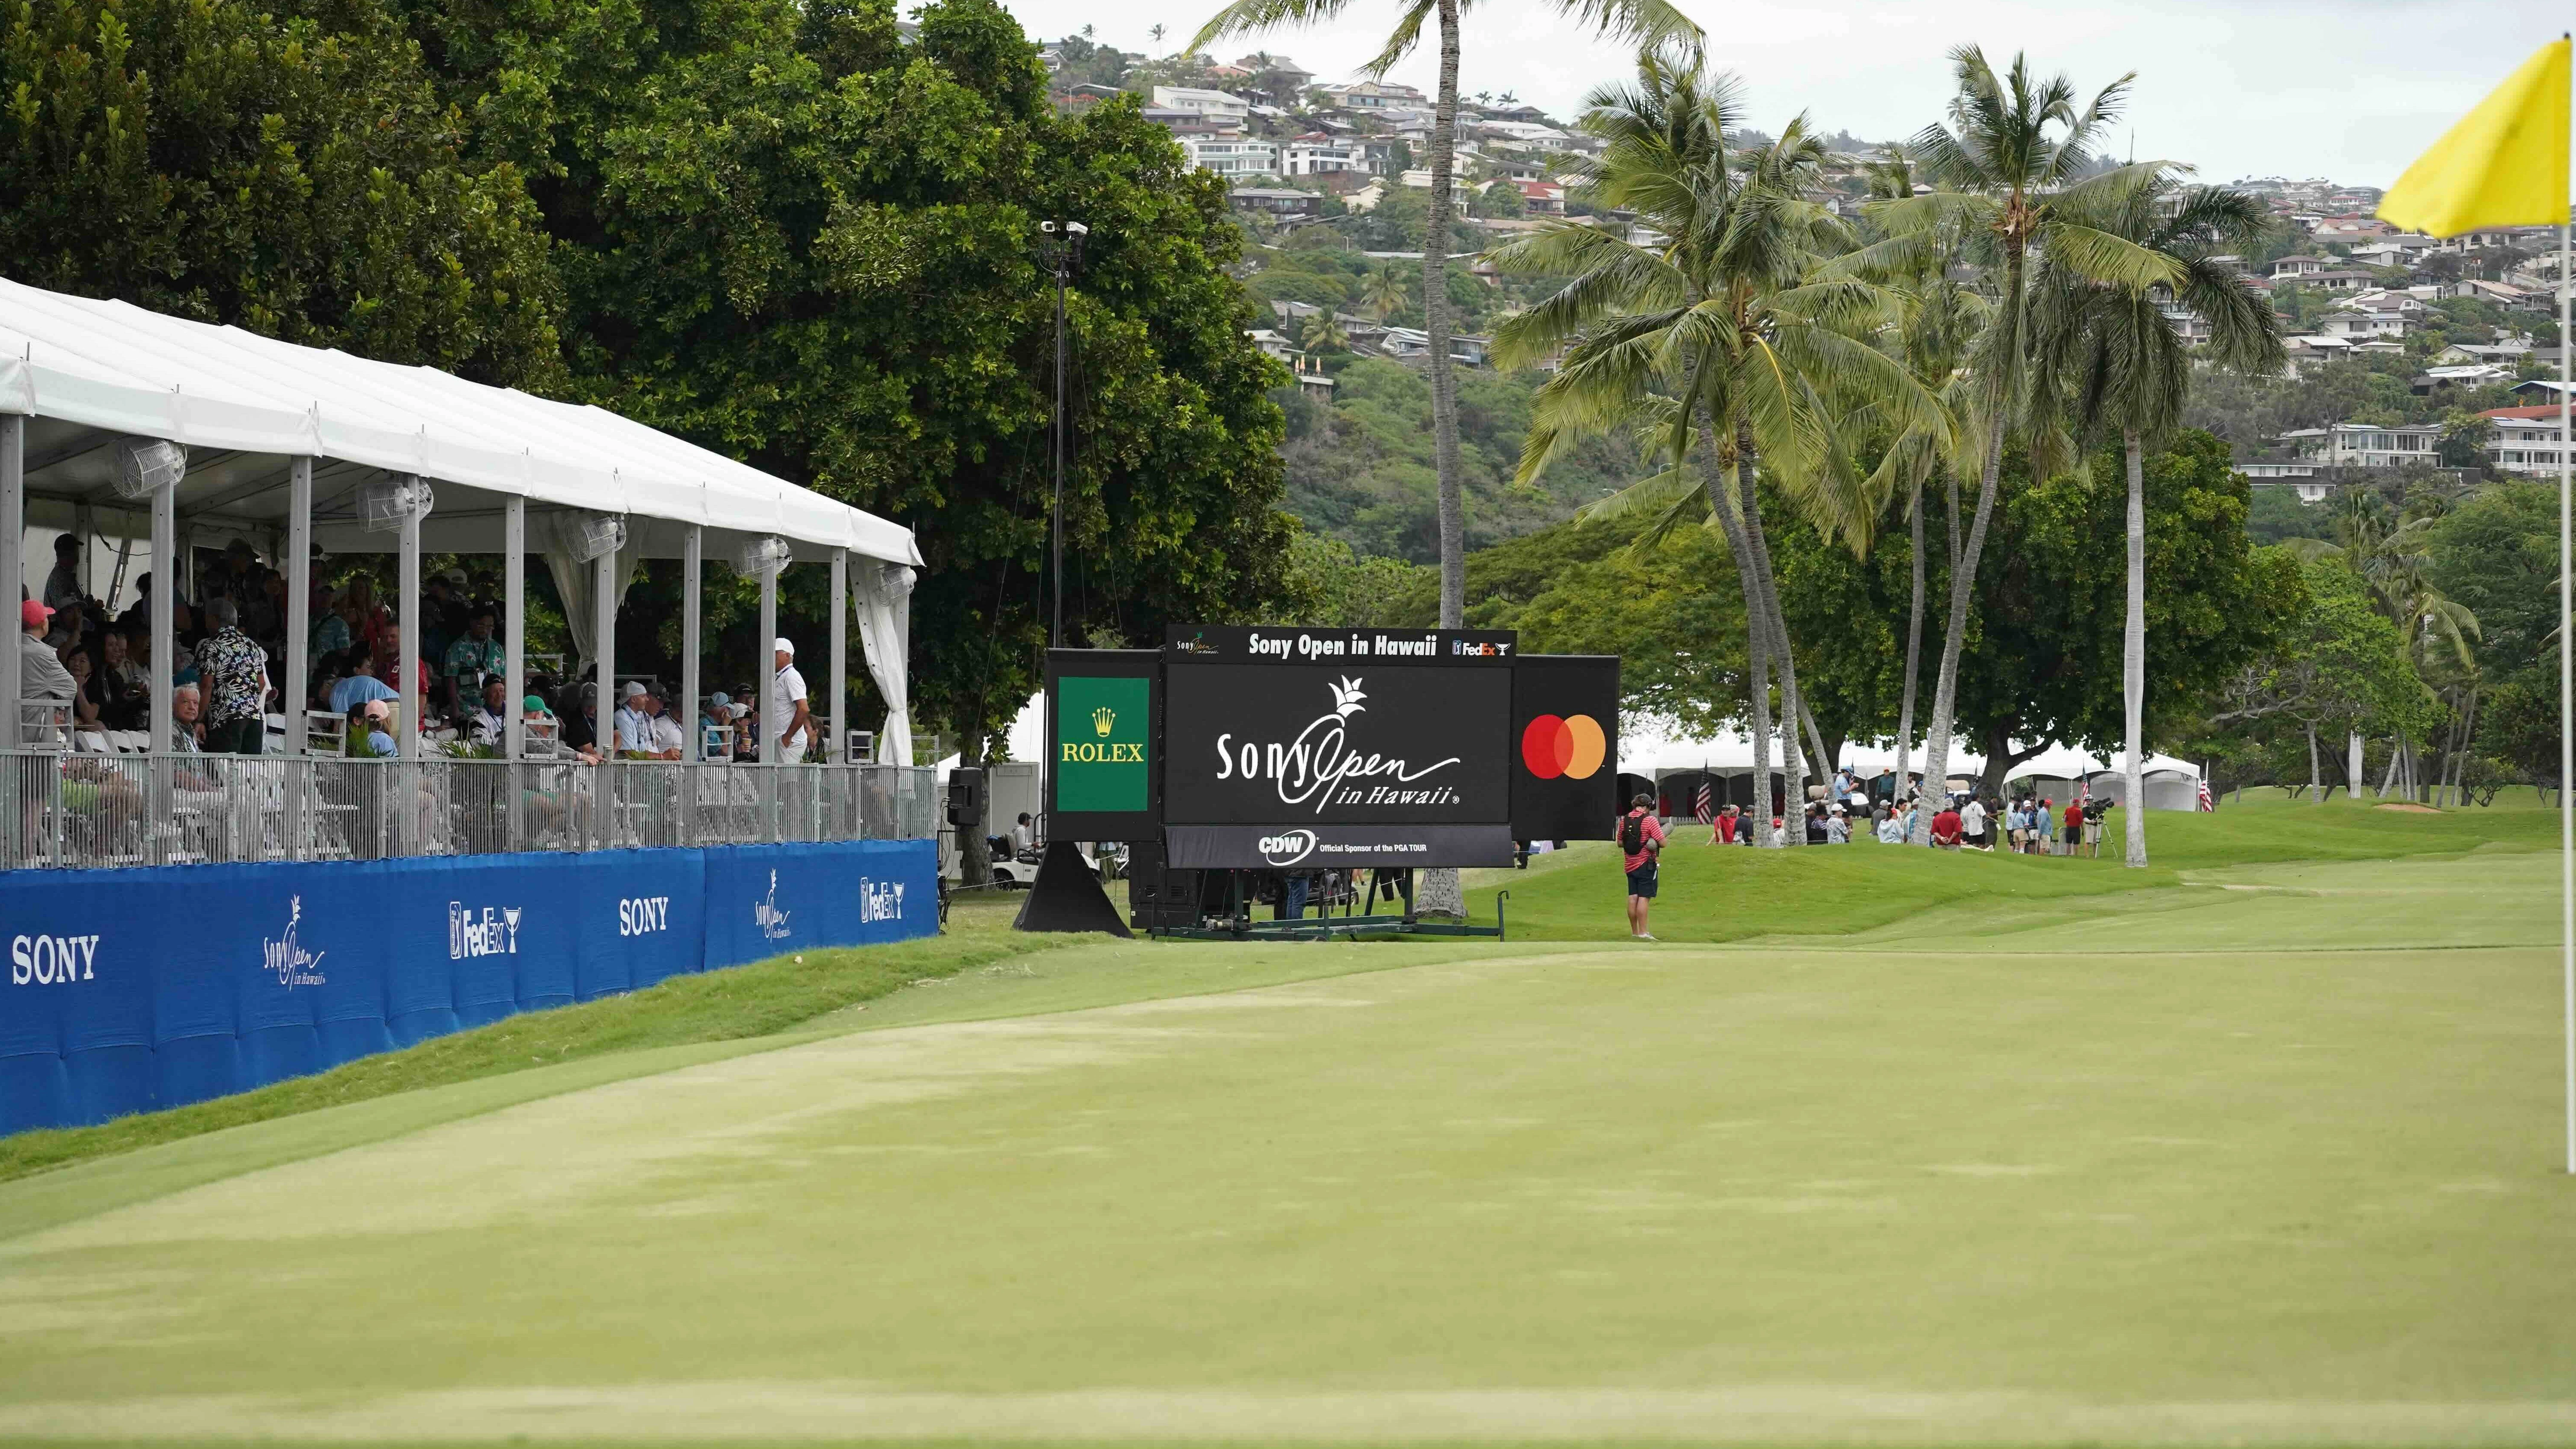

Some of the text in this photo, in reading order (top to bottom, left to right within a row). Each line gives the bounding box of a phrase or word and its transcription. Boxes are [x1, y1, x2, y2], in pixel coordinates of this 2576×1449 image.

[1177, 641, 1194, 651] Sony
[1249, 633, 1437, 660] Sony Open in Hawaii
[1462, 642, 1495, 656] FedEx
[1062, 743, 1144, 762] ROLEX
[1217, 714, 1460, 814] Sony Open
[1336, 786, 1363, 804] in
[1259, 837, 1303, 853] CDW
[1320, 844, 1343, 852] Official
[1345, 844, 1372, 853] Sponsor
[1409, 844, 1427, 852] TOUR
[620, 897, 669, 936] SONY
[755, 889, 790, 944] Sony Open
[869, 882, 894, 921] FedEx
[463, 907, 505, 958] FedEx
[12, 934, 99, 985] SONY
[264, 921, 325, 992] Sony Open
[294, 973, 301, 985] in
